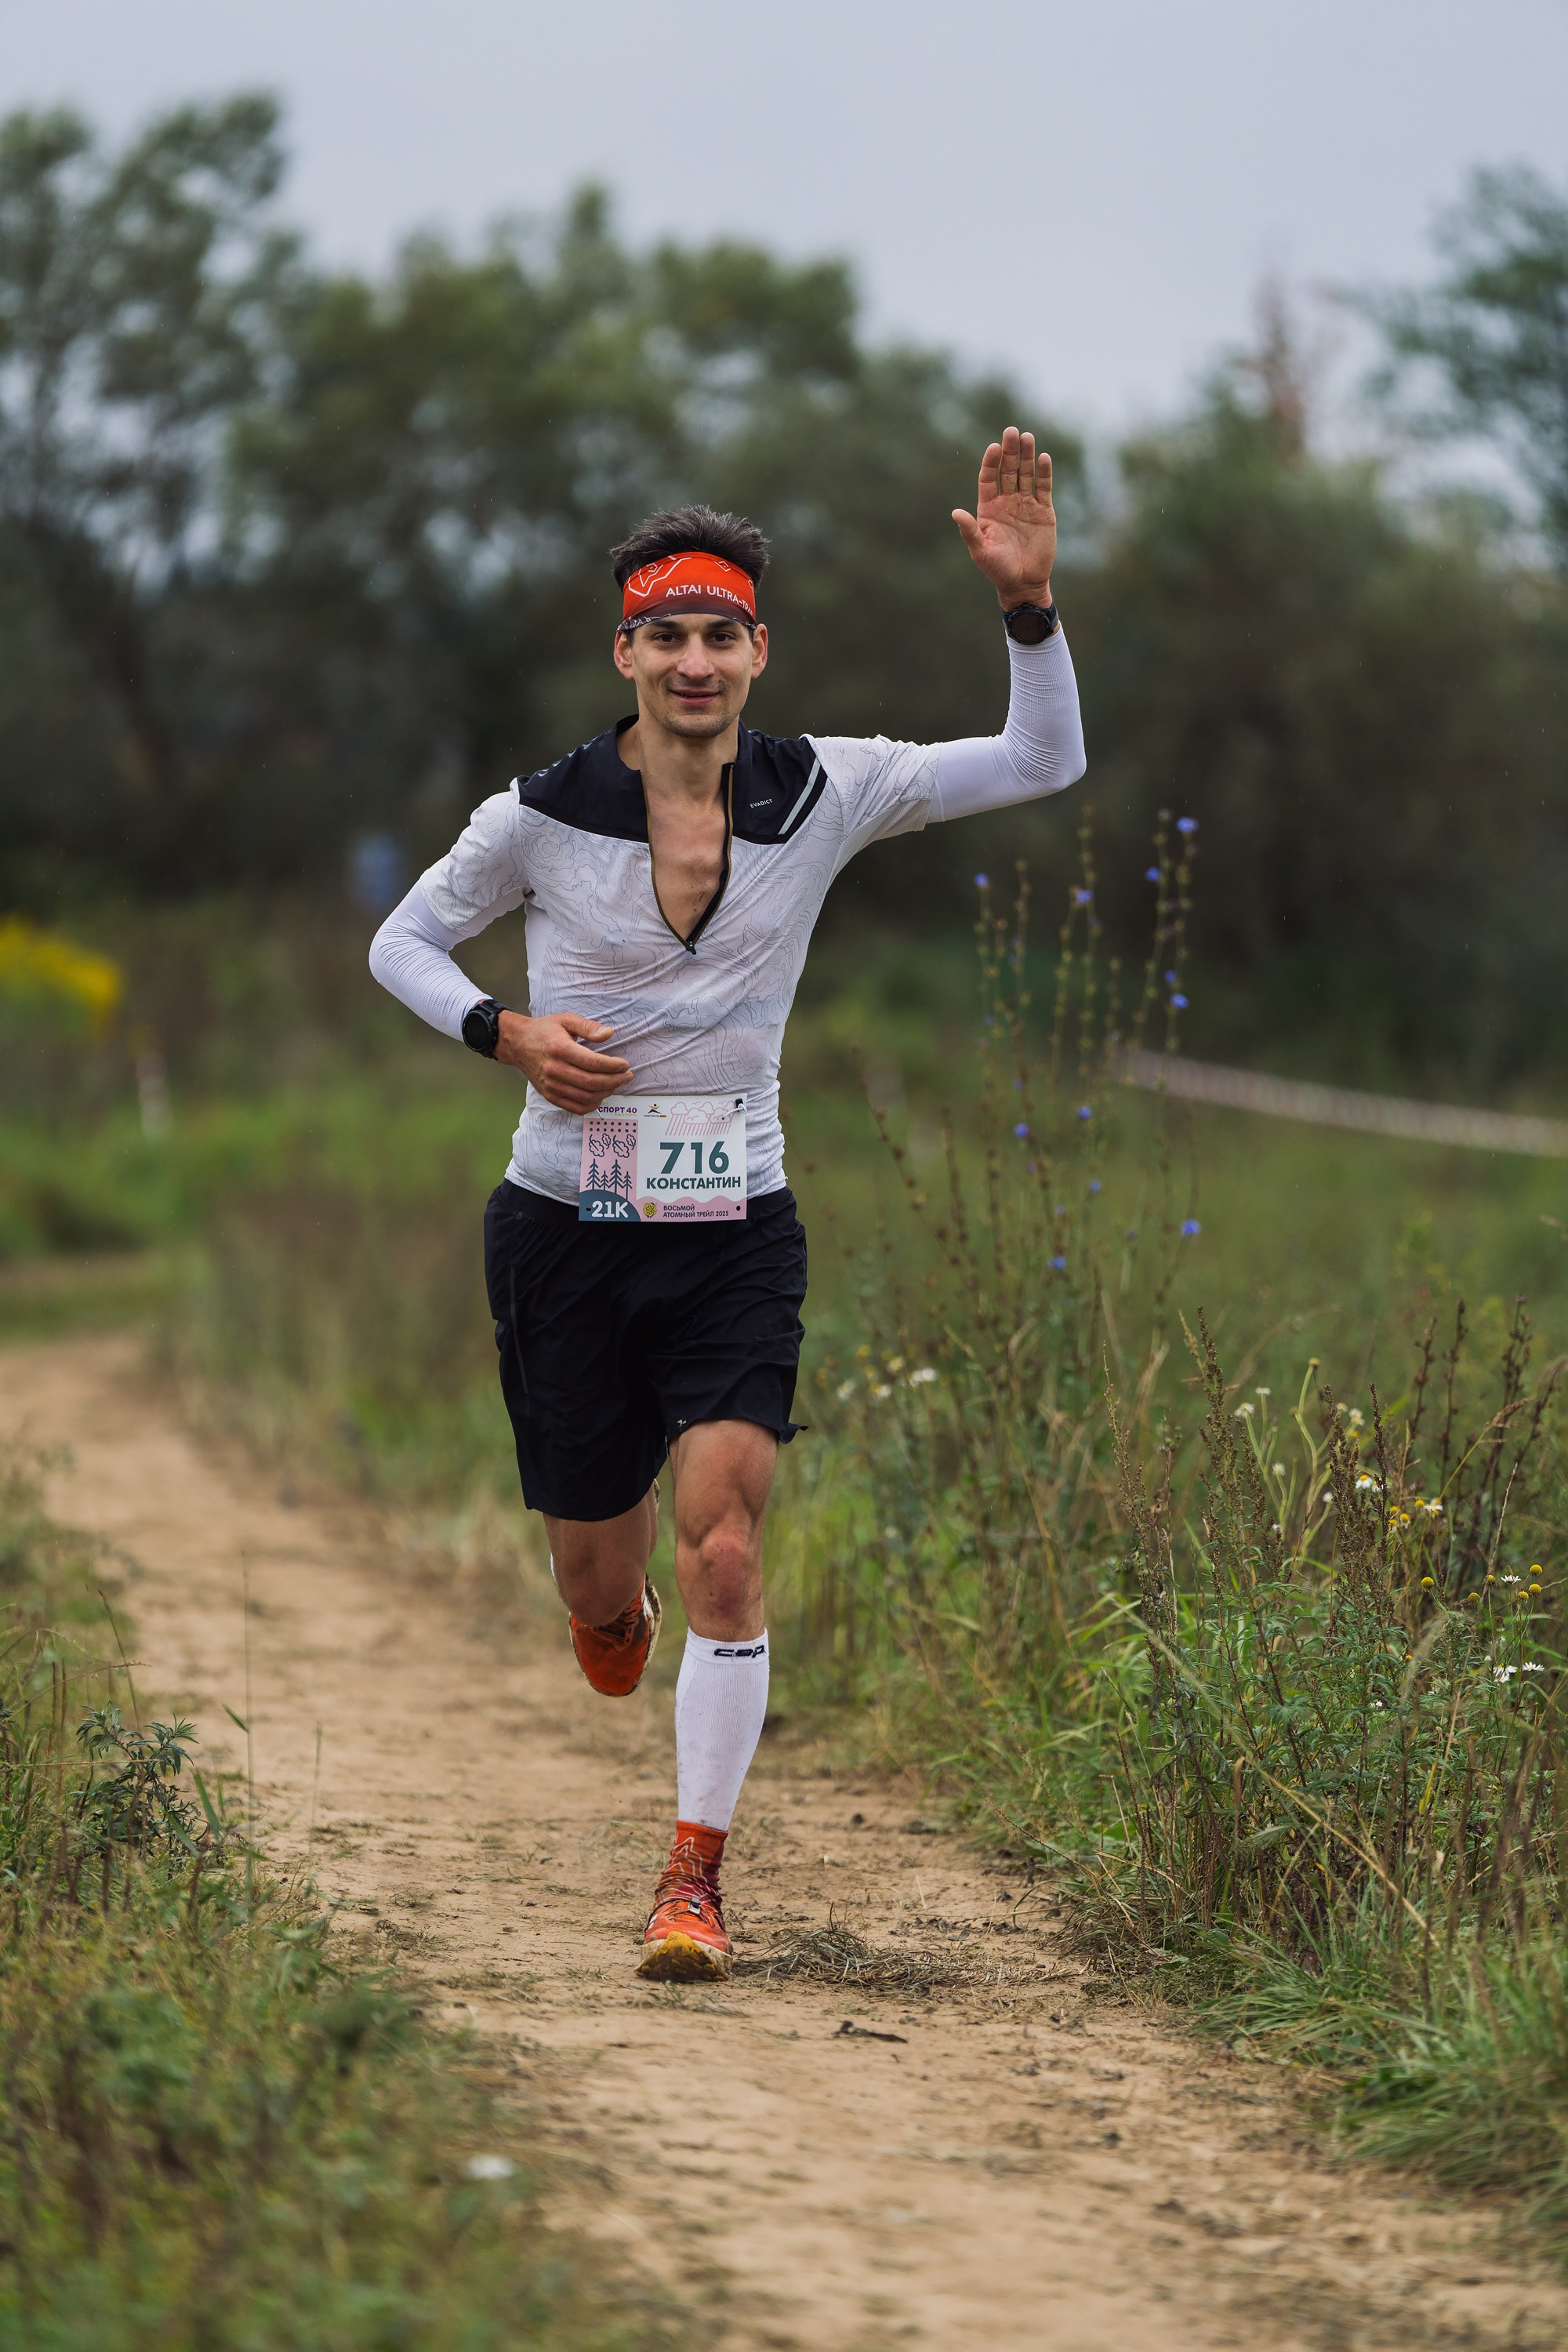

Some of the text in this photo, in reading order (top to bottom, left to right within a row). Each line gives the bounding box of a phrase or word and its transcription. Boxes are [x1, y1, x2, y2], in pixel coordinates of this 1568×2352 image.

[666, 584, 701, 597] ALTAI
[750, 798, 773, 808] EVADICT
[659, 1141, 730, 1174] 716
[646, 1176, 741, 1190] КОНСТАНТИН
[591, 1200, 629, 1218] 21K
